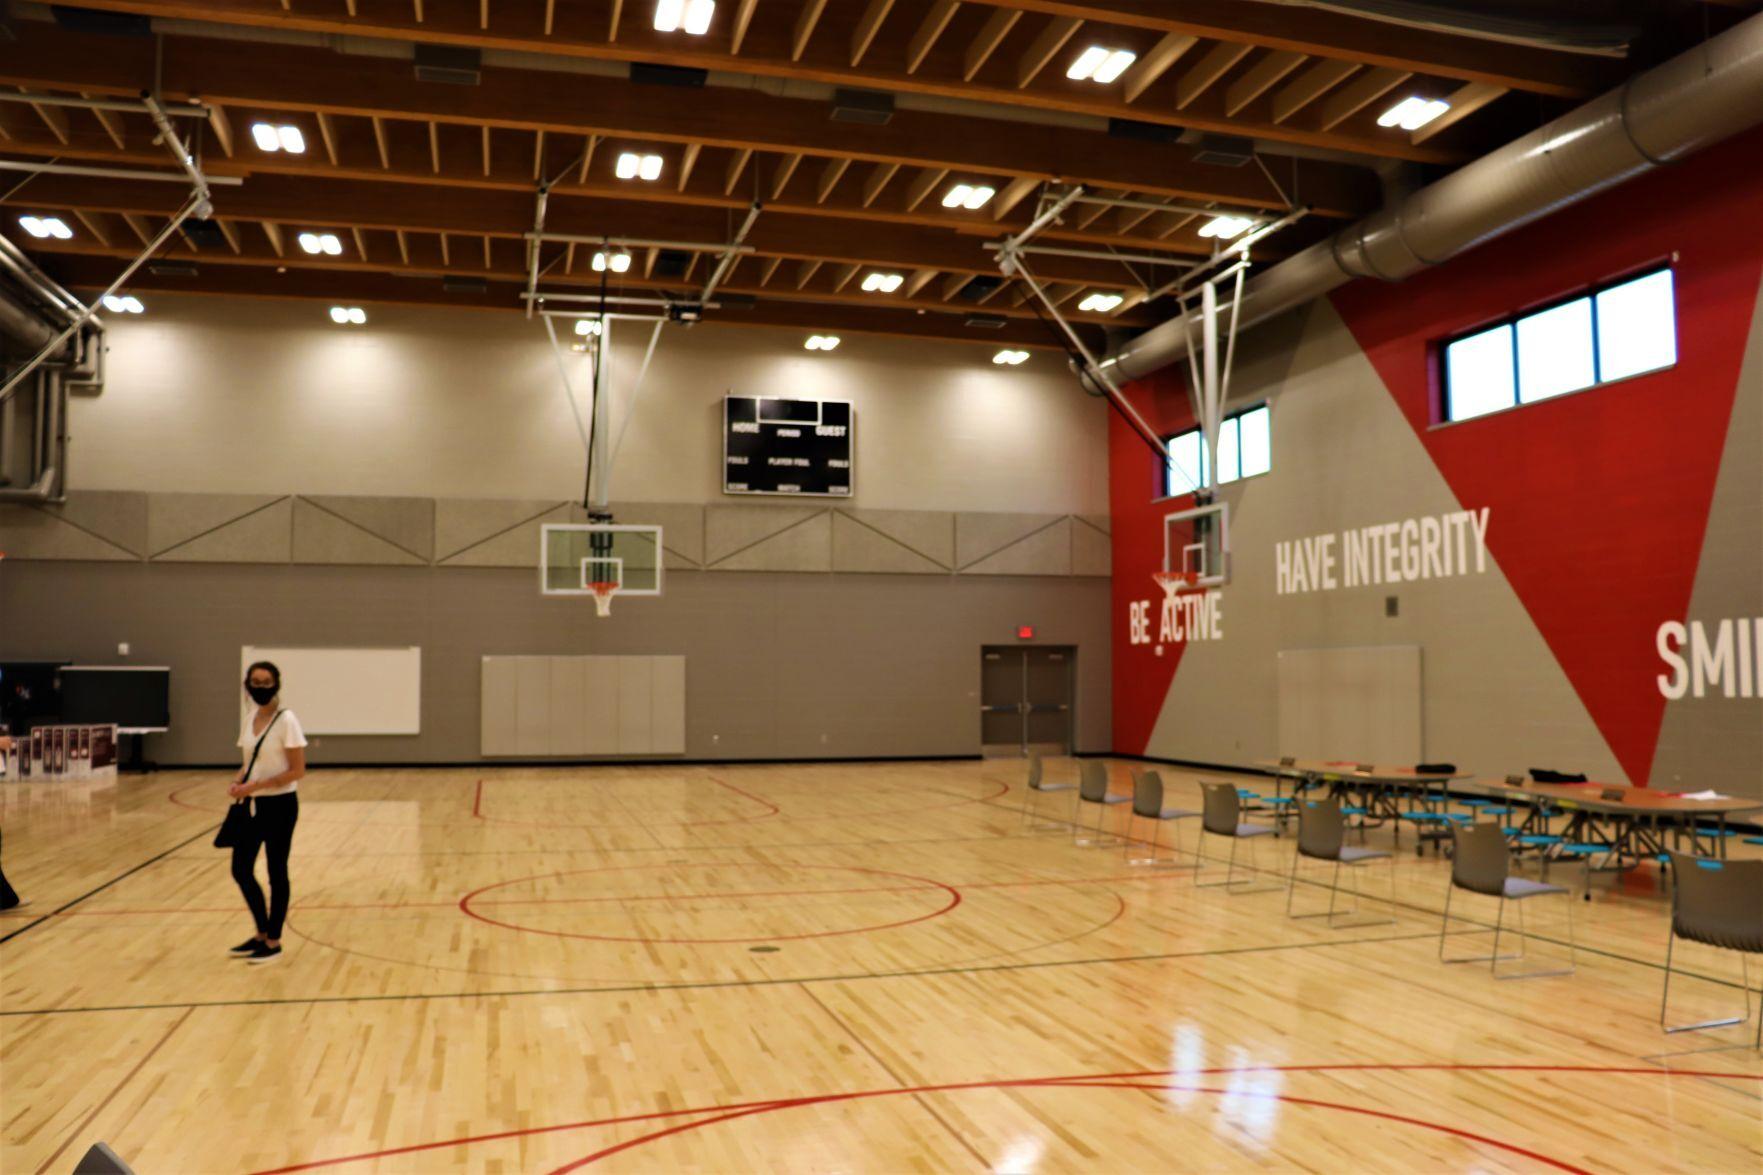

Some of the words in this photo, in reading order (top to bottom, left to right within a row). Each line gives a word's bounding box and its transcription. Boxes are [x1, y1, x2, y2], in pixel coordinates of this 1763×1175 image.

[732, 422, 760, 433] HOME
[815, 425, 846, 437] GUEST
[1275, 533, 1337, 594] HAVE
[1343, 507, 1490, 587] INTEGRITY
[1129, 599, 1151, 644] BE
[1159, 592, 1223, 642] ACTIVE
